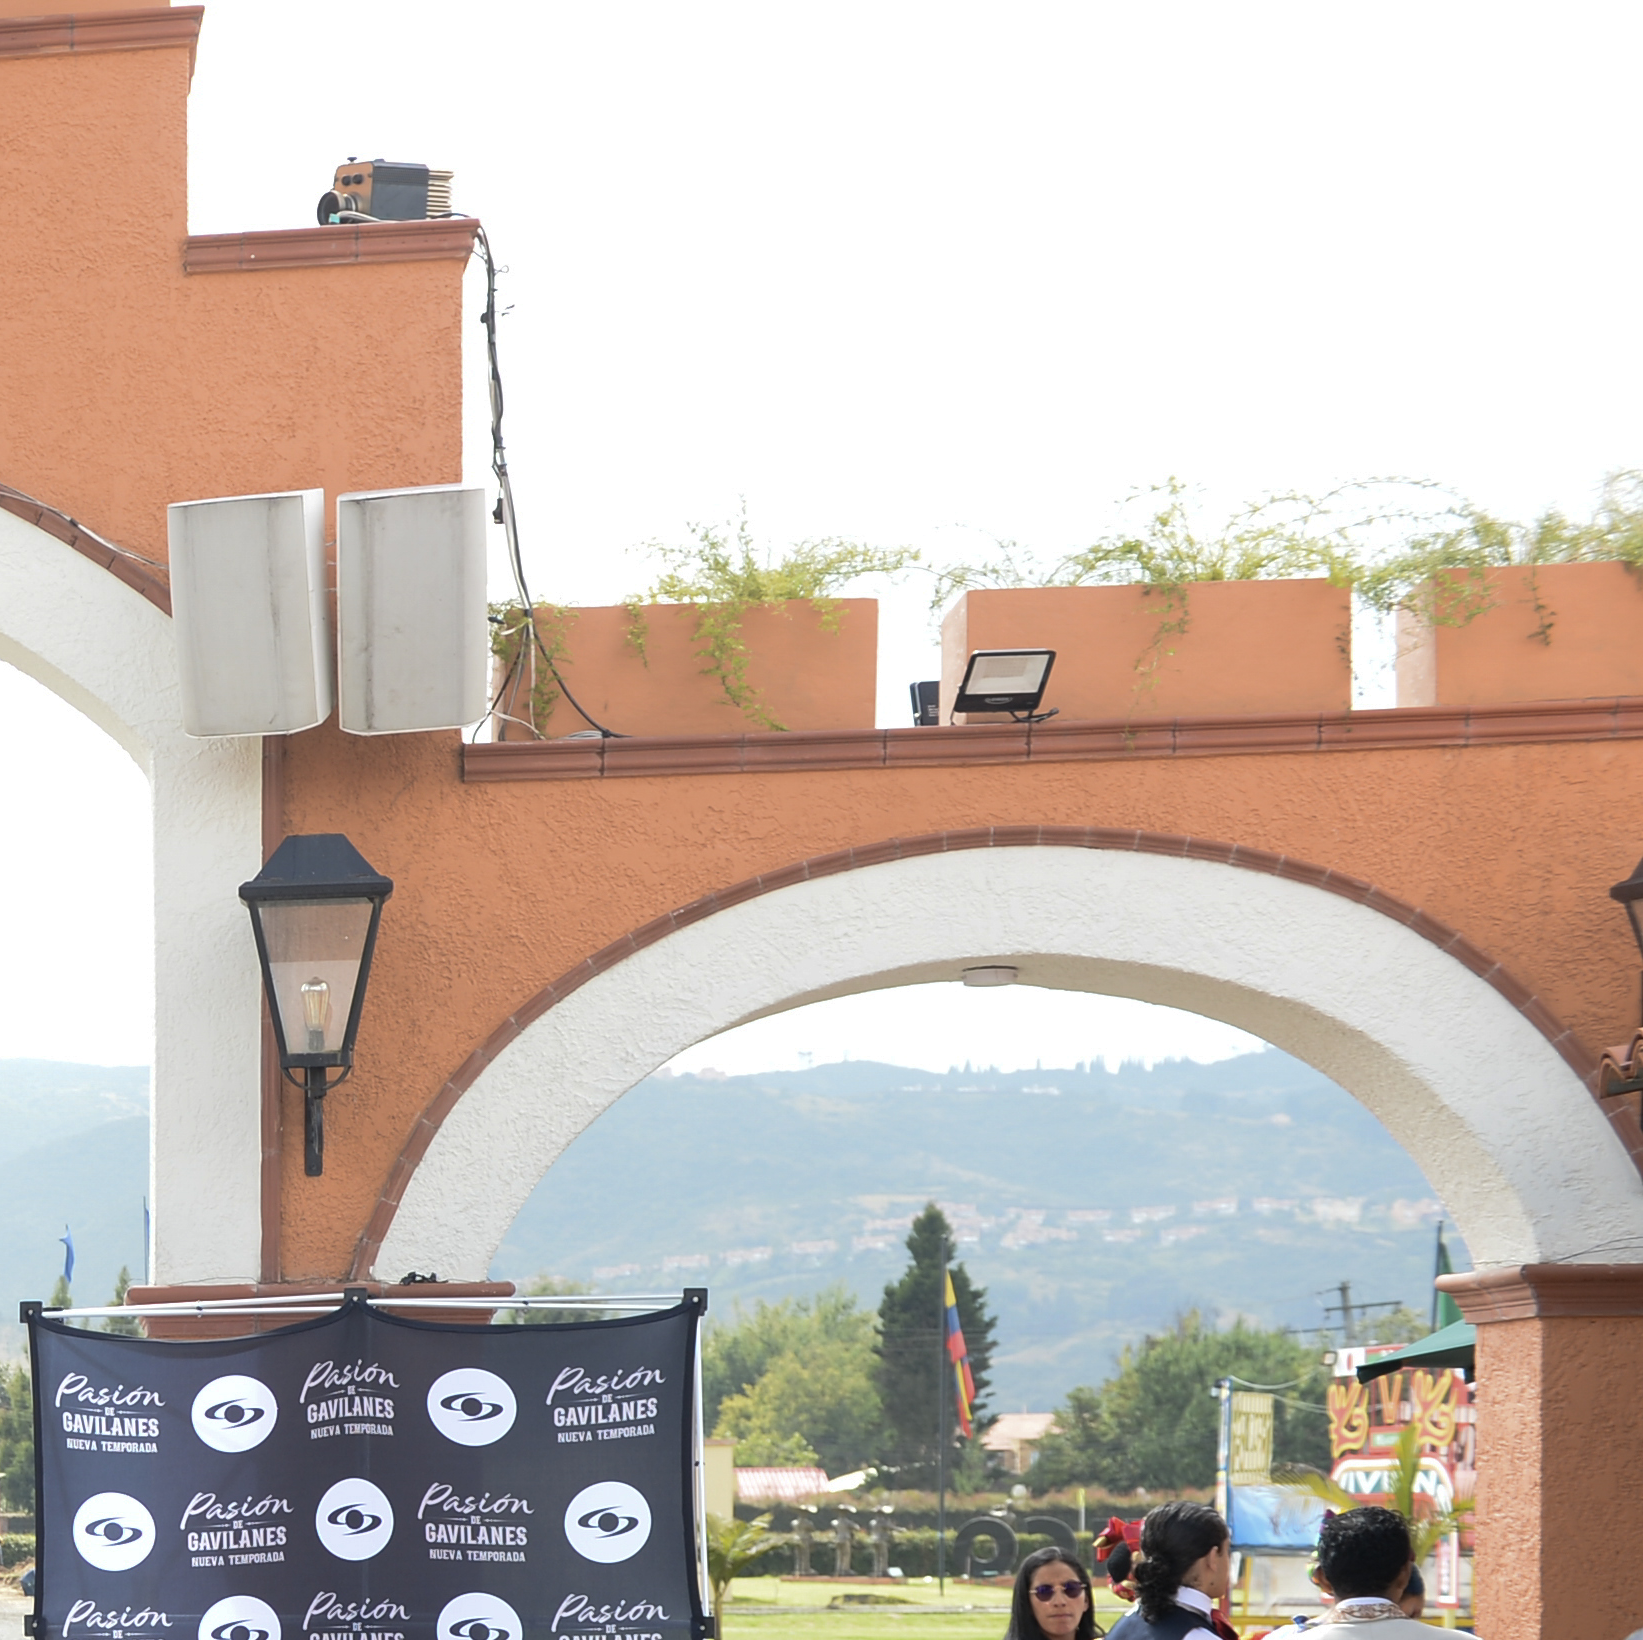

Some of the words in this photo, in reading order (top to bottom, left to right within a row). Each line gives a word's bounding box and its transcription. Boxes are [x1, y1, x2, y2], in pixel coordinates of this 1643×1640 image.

[55, 1372, 166, 1408] Pasión
[299, 1358, 400, 1404] Pasión
[545, 1366, 665, 1406] Pasión
[307, 1395, 395, 1424] GAVILANES
[553, 1397, 658, 1427] GAVILANES
[62, 1411, 160, 1438] GAVILANES
[310, 1424, 341, 1440] NUEVA
[343, 1422, 394, 1436] TEMPORADA
[557, 1430, 593, 1443] NUEVA
[596, 1423, 655, 1441] TEMPORADA
[66, 1437, 98, 1451] NUEVA
[100, 1440, 158, 1454] TEMPORADA
[179, 1492, 293, 1531] Pasión
[417, 1482, 535, 1520] Pasión
[187, 1525, 287, 1552] GAVILANES
[425, 1522, 528, 1546] GAVILANES
[191, 1555, 225, 1568] NUEVA
[228, 1551, 285, 1566] TEMPORADA
[429, 1548, 463, 1561] NUEVA
[466, 1550, 526, 1562] TEMPORADA
[62, 1599, 173, 1638] Pasión
[302, 1591, 411, 1631] Pasión
[551, 1593, 670, 1633] Pasión
